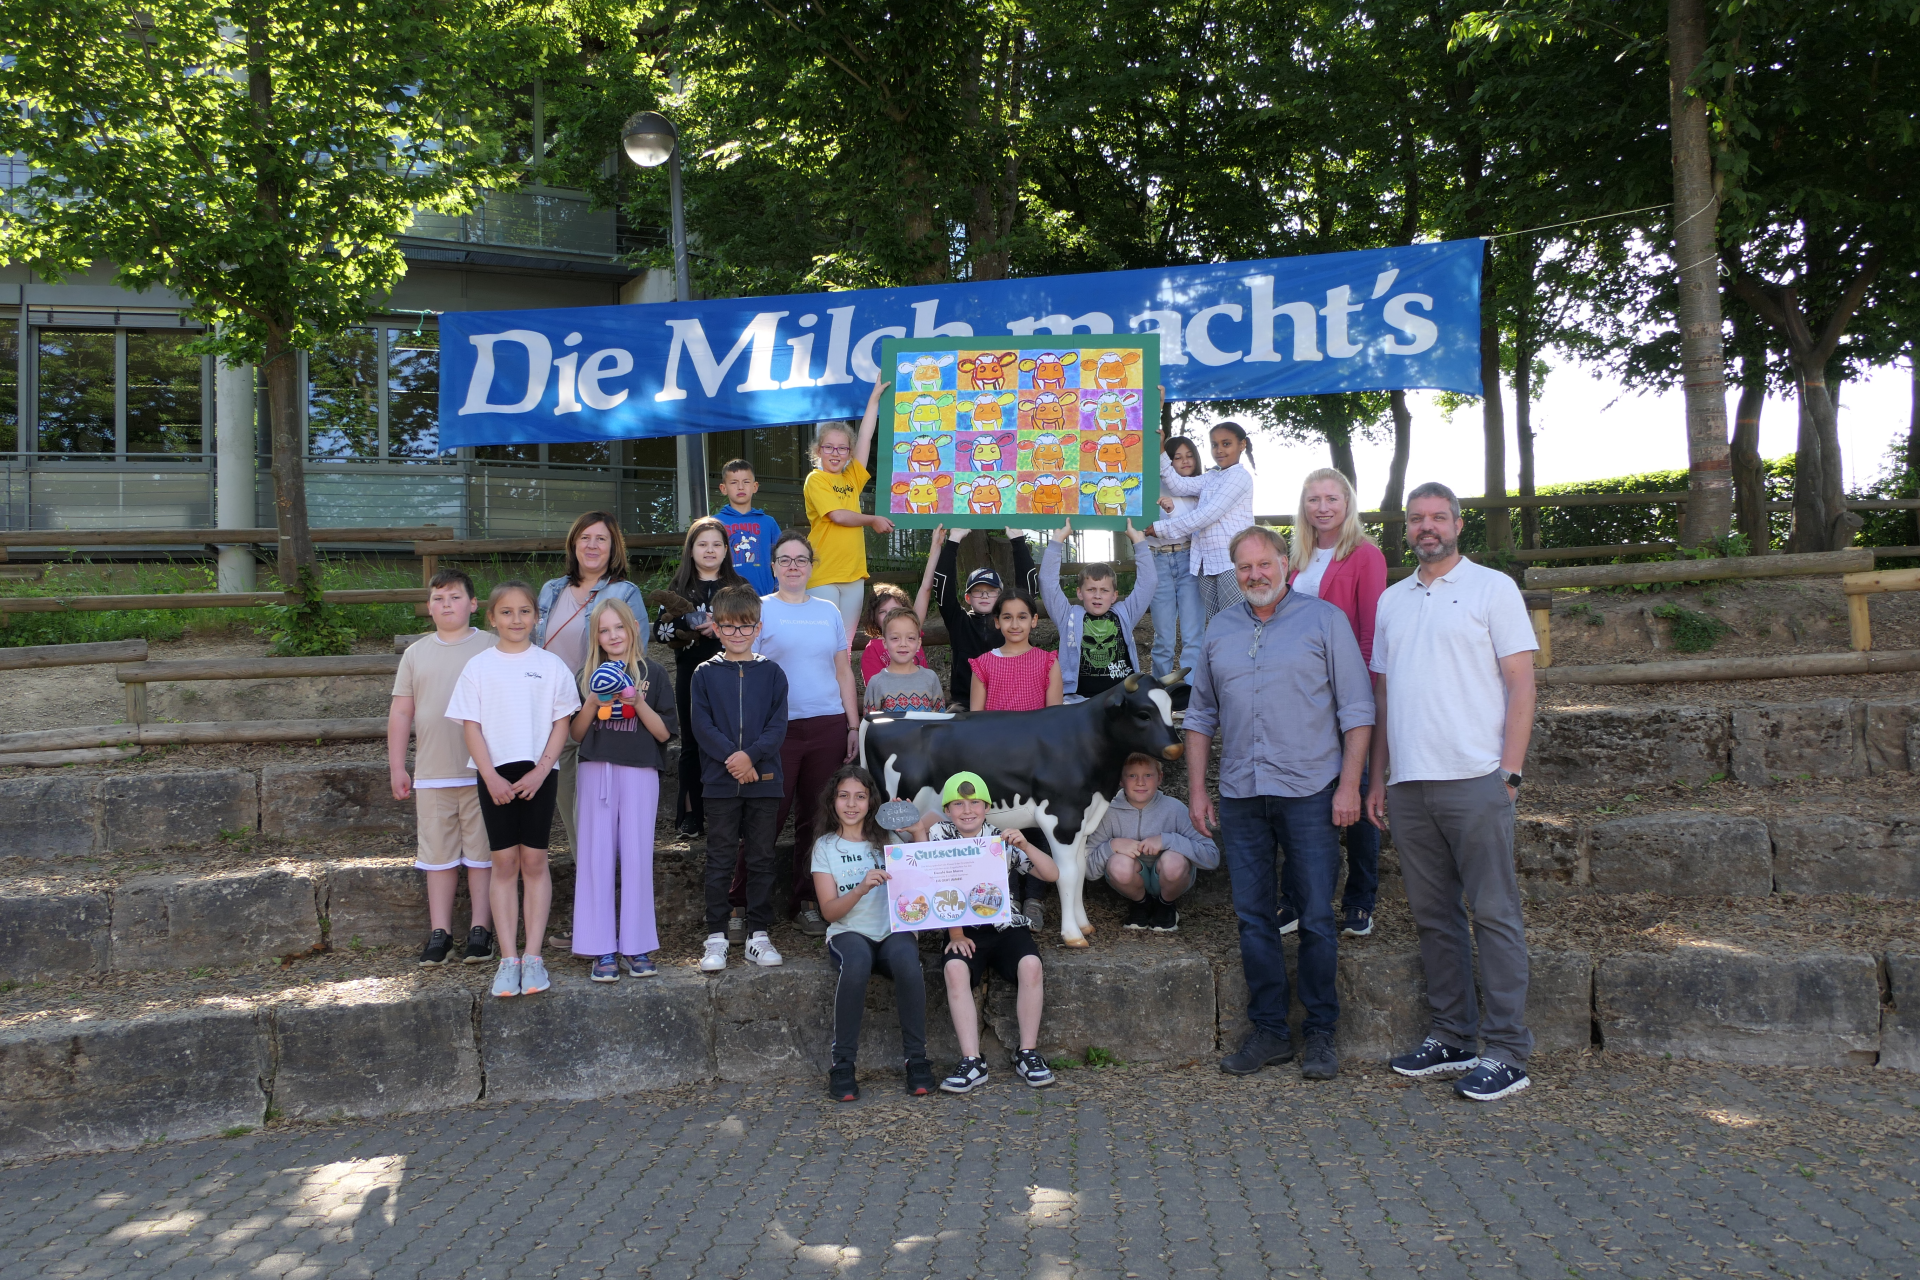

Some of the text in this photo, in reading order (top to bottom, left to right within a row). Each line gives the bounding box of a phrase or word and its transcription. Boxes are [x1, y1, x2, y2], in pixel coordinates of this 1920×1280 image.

[458, 329, 634, 416] Die
[724, 522, 761, 537] SONIC
[840, 853, 863, 863] This
[914, 845, 981, 860] Gutschein
